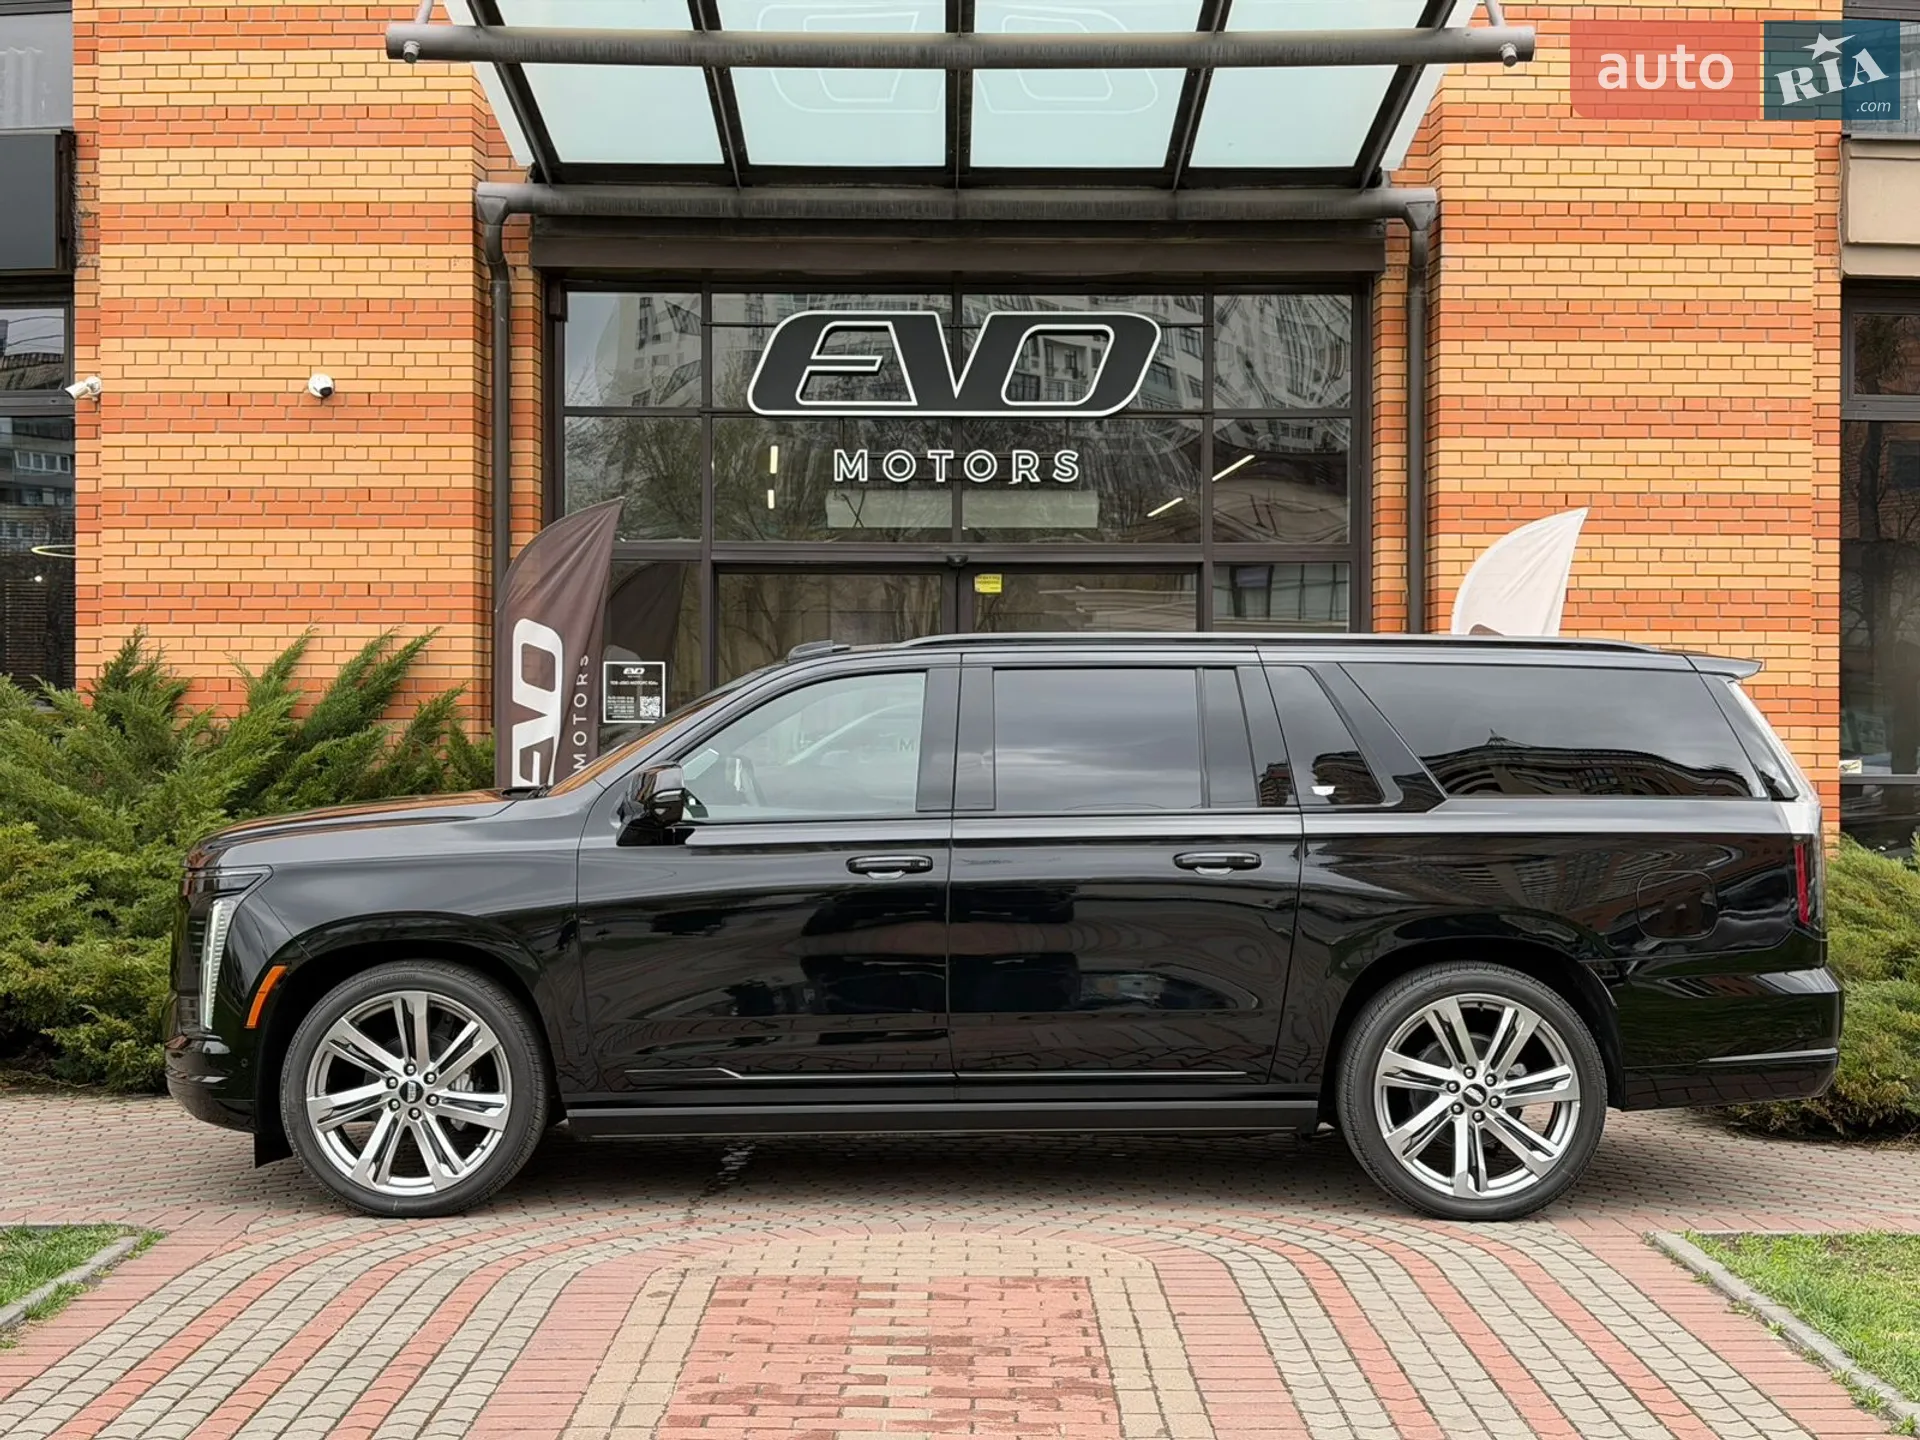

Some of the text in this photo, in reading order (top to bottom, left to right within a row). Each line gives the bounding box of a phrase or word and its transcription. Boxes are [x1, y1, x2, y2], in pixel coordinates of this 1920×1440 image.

[747, 310, 1162, 417] EVO
[833, 449, 1080, 484] MOTORS
[573, 655, 589, 774] MOTORS
